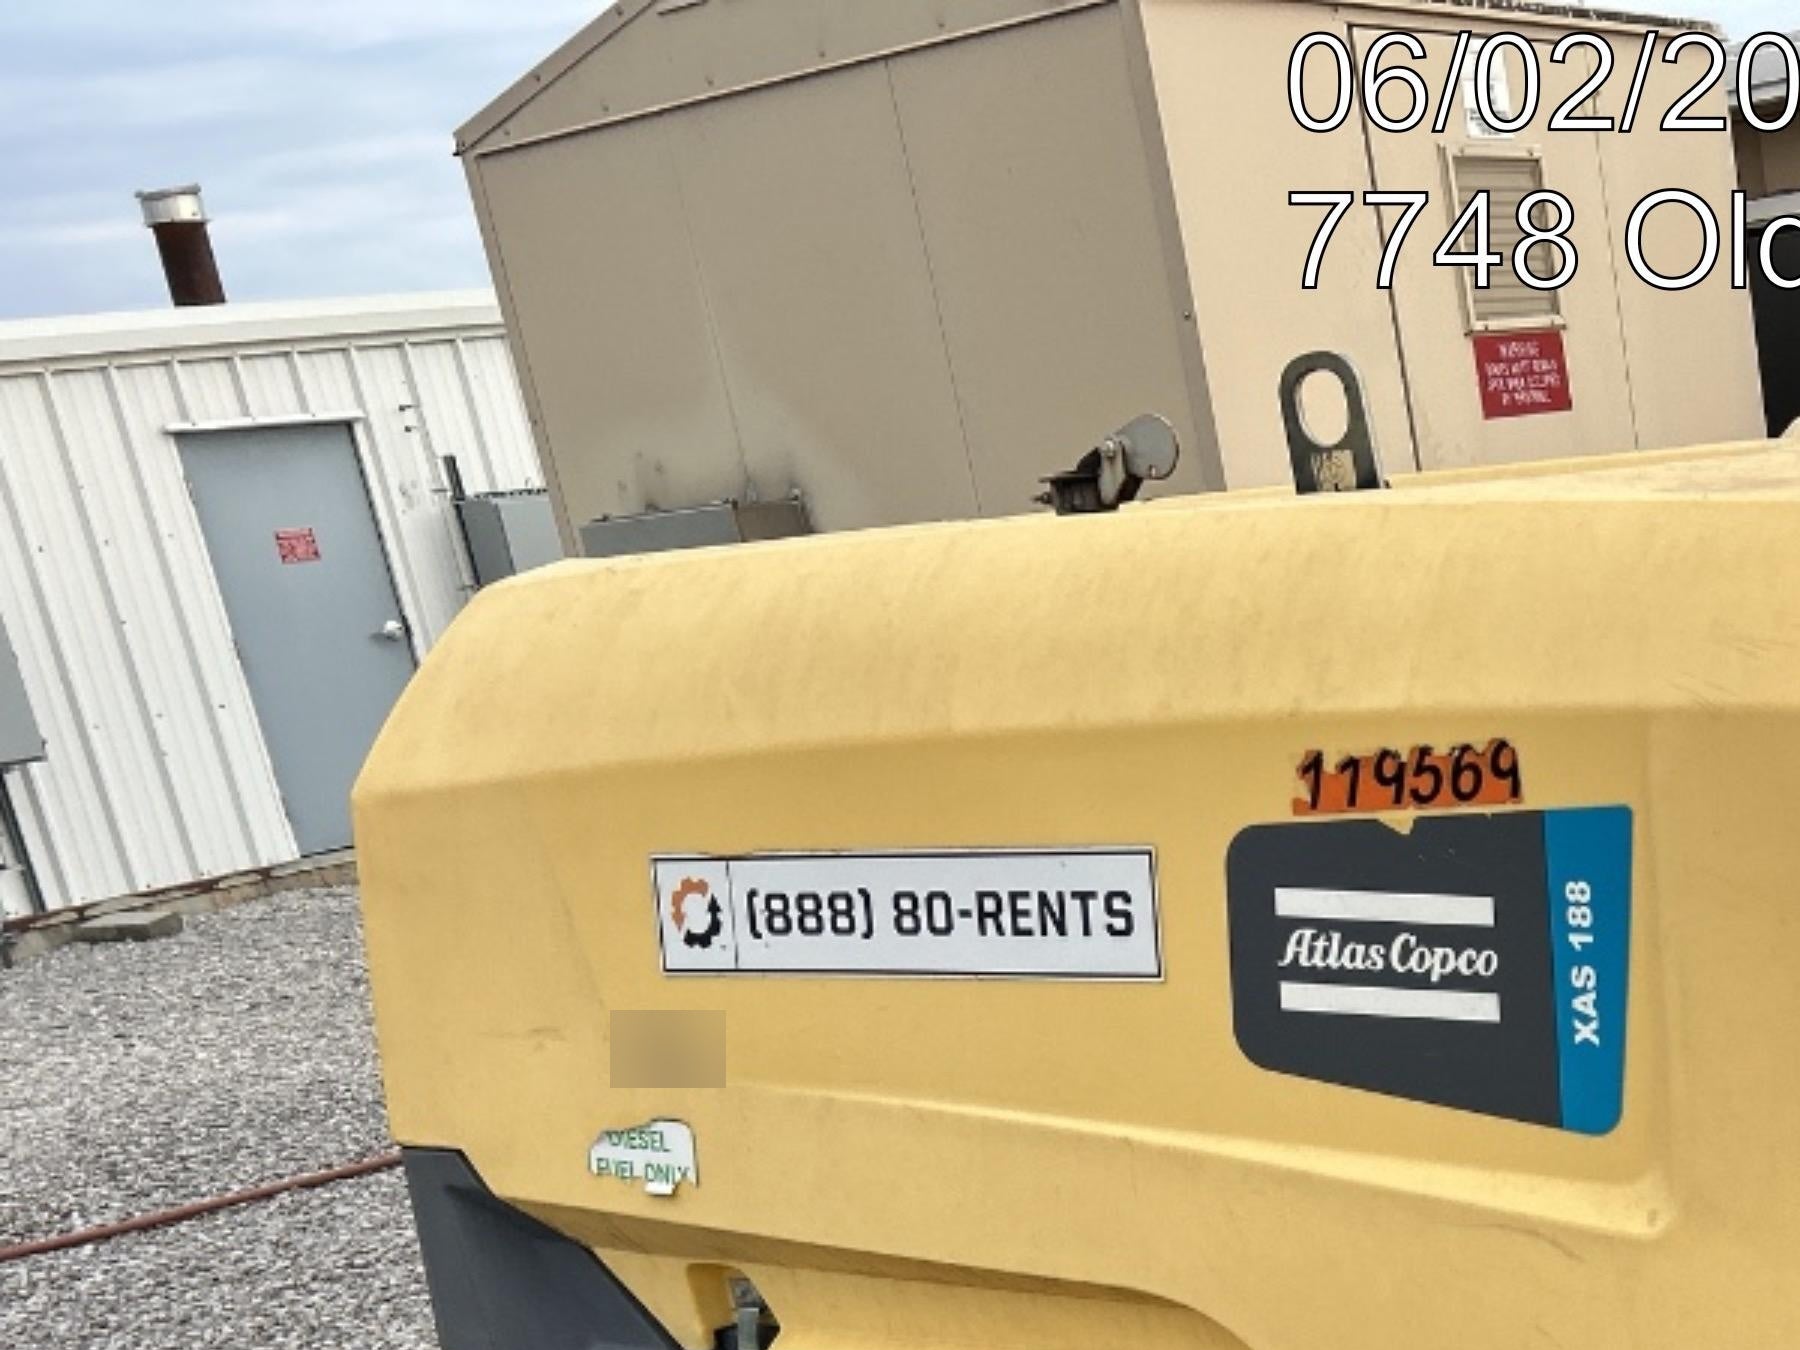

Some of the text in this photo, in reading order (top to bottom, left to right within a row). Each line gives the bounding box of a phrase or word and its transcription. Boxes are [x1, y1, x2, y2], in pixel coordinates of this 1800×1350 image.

[1300, 738, 1522, 810] 119569
[745, 887, 1135, 940] (888) 80-RENTS
[1277, 928, 1498, 983] Atlas Copco
[1565, 880, 1600, 1047] XAS 188
